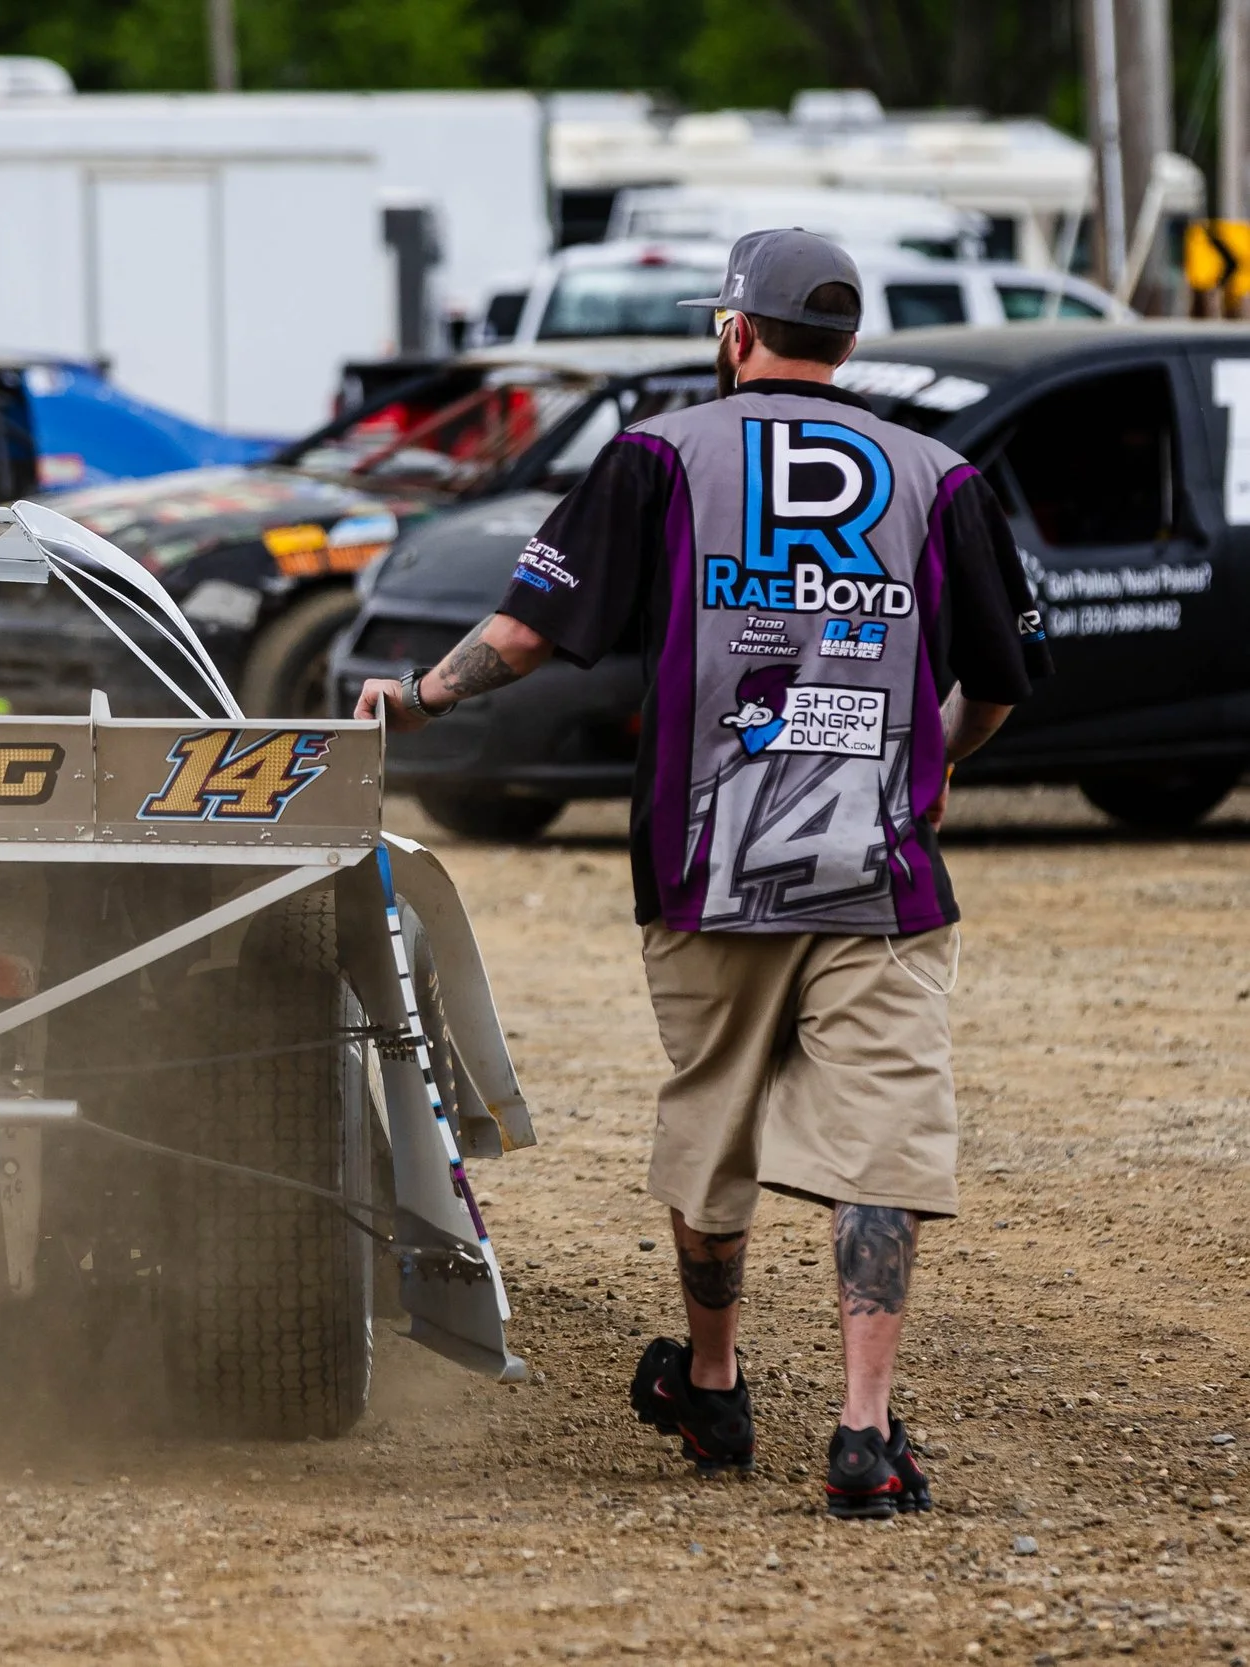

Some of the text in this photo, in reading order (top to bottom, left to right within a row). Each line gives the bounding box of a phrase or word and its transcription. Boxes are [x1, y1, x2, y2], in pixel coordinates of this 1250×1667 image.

[747, 616, 785, 630] TODD
[729, 642, 799, 656] TRUCKING
[821, 639, 883, 652] HAULING
[819, 648, 882, 660] SERVICE
[794, 692, 879, 713] SHOP
[791, 711, 878, 732] ANGRY
[692, 745, 902, 922] 14
